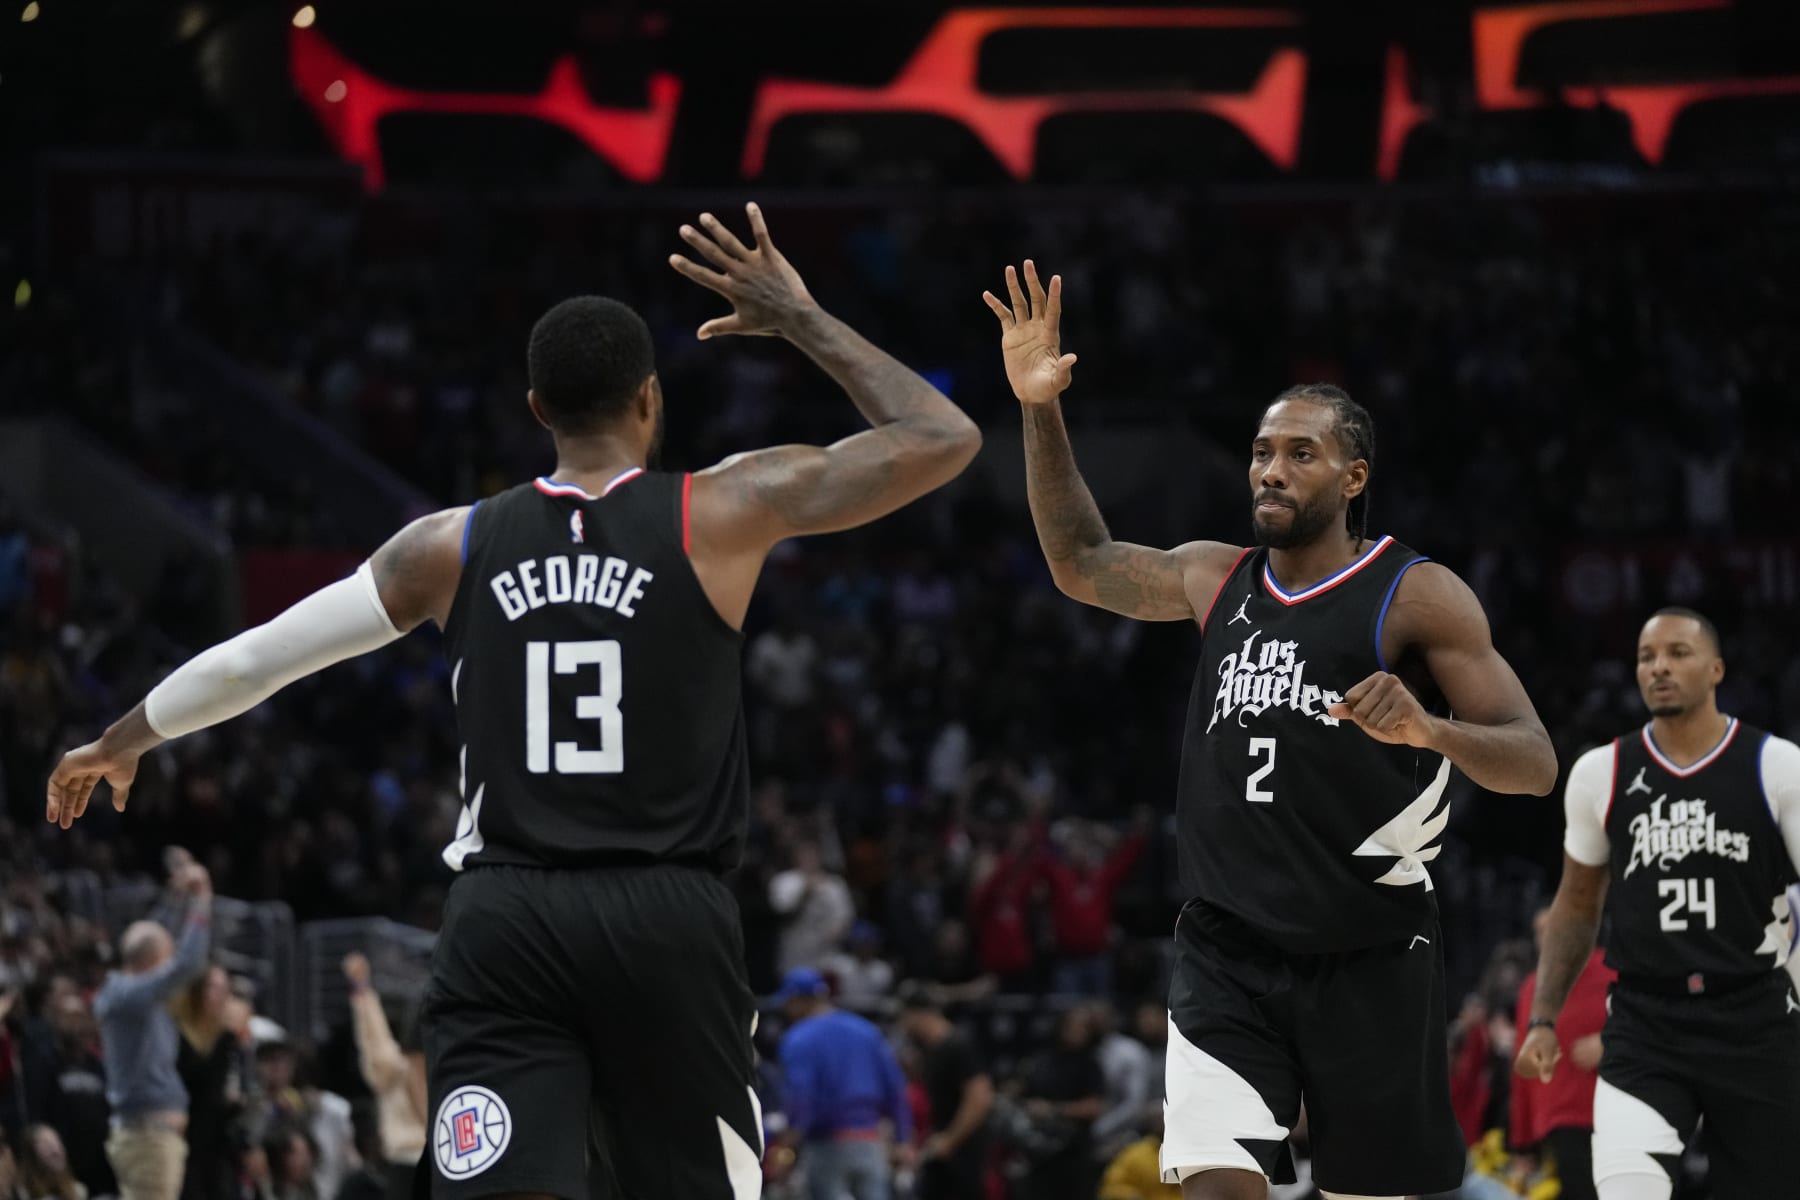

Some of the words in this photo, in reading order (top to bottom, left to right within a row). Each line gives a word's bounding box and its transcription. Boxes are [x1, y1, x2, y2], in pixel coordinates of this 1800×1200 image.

[490, 554, 654, 621] GEORGE
[1235, 629, 1300, 676] Los
[526, 639, 625, 774] 13
[1206, 652, 1344, 735] Angeles
[1245, 737, 1277, 803] 2
[1649, 793, 1707, 829] Los
[1623, 812, 1750, 880] Angeles
[1658, 877, 1717, 932] 24
